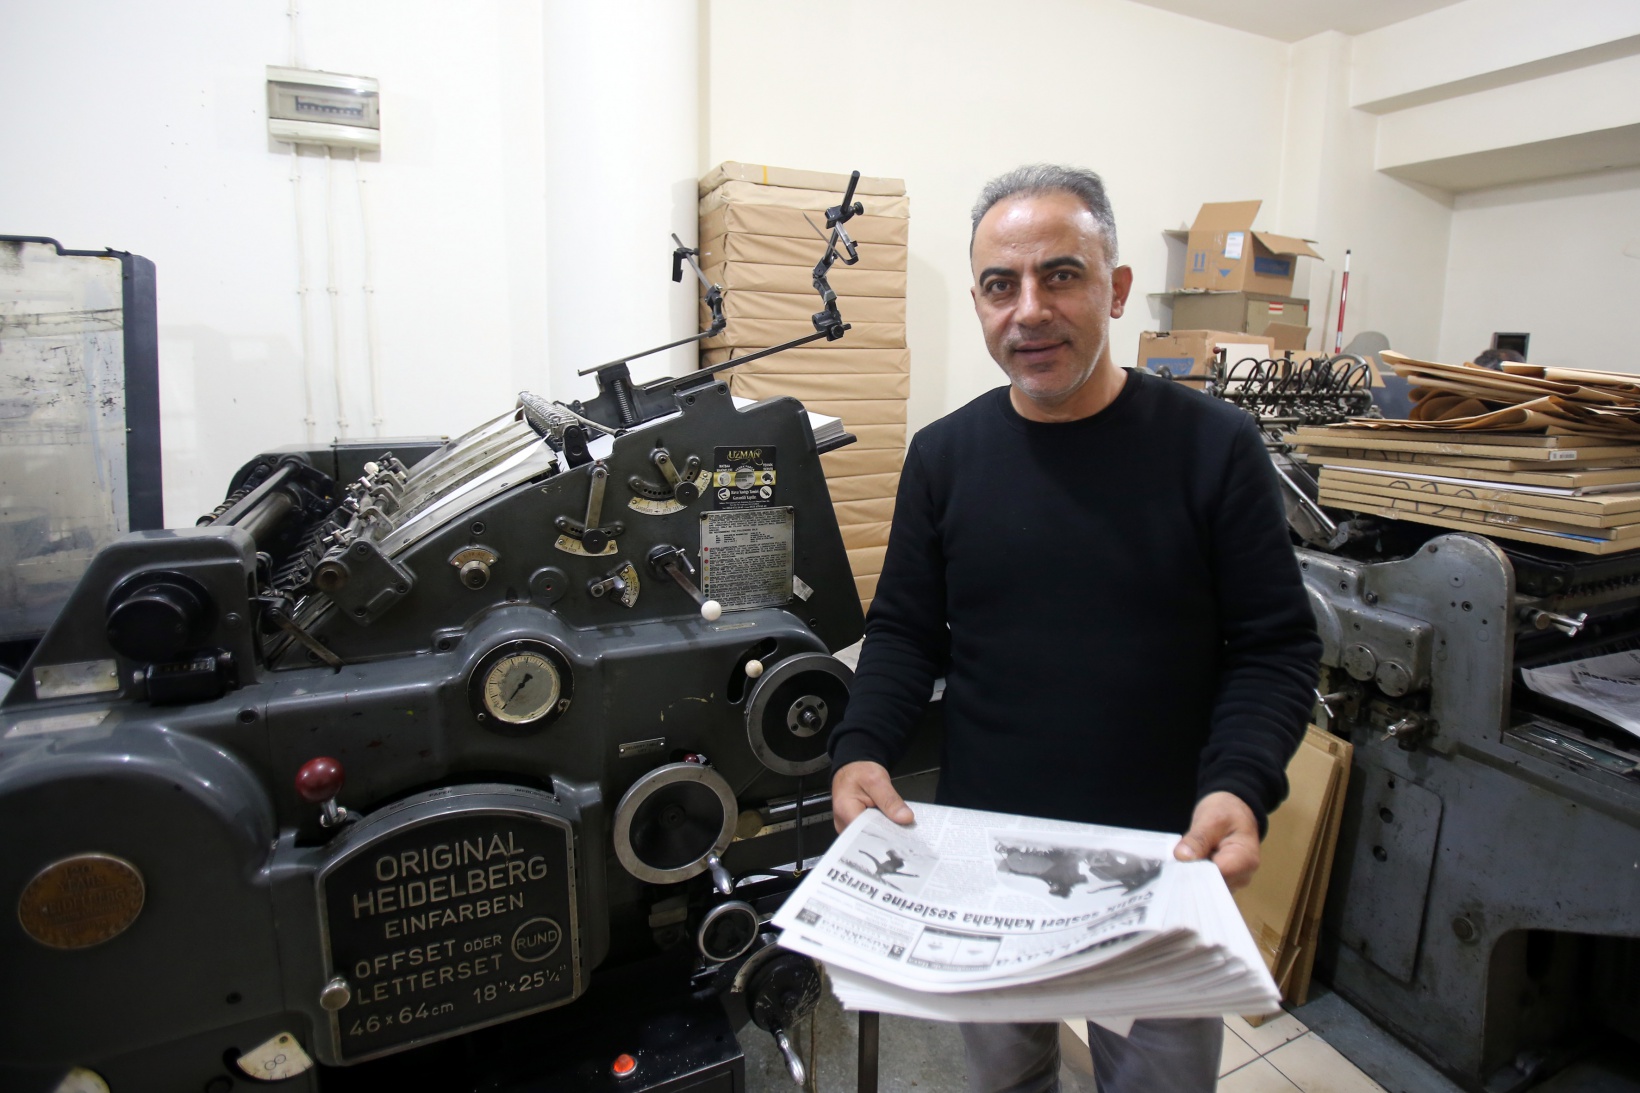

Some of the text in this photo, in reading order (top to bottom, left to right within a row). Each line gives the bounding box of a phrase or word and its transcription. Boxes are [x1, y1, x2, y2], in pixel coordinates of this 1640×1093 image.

[375, 831, 525, 882] ORIGINAL
[353, 856, 548, 919] HEIDELBERG
[826, 868, 879, 902] karıştı
[384, 892, 524, 939] EINFARBEN
[881, 892, 958, 923] seslerine
[963, 913, 1035, 930] kahkaha
[355, 935, 502, 979] OFFSET ODER
[515, 930, 558, 951] RUND
[357, 953, 503, 1005] LETTERSET
